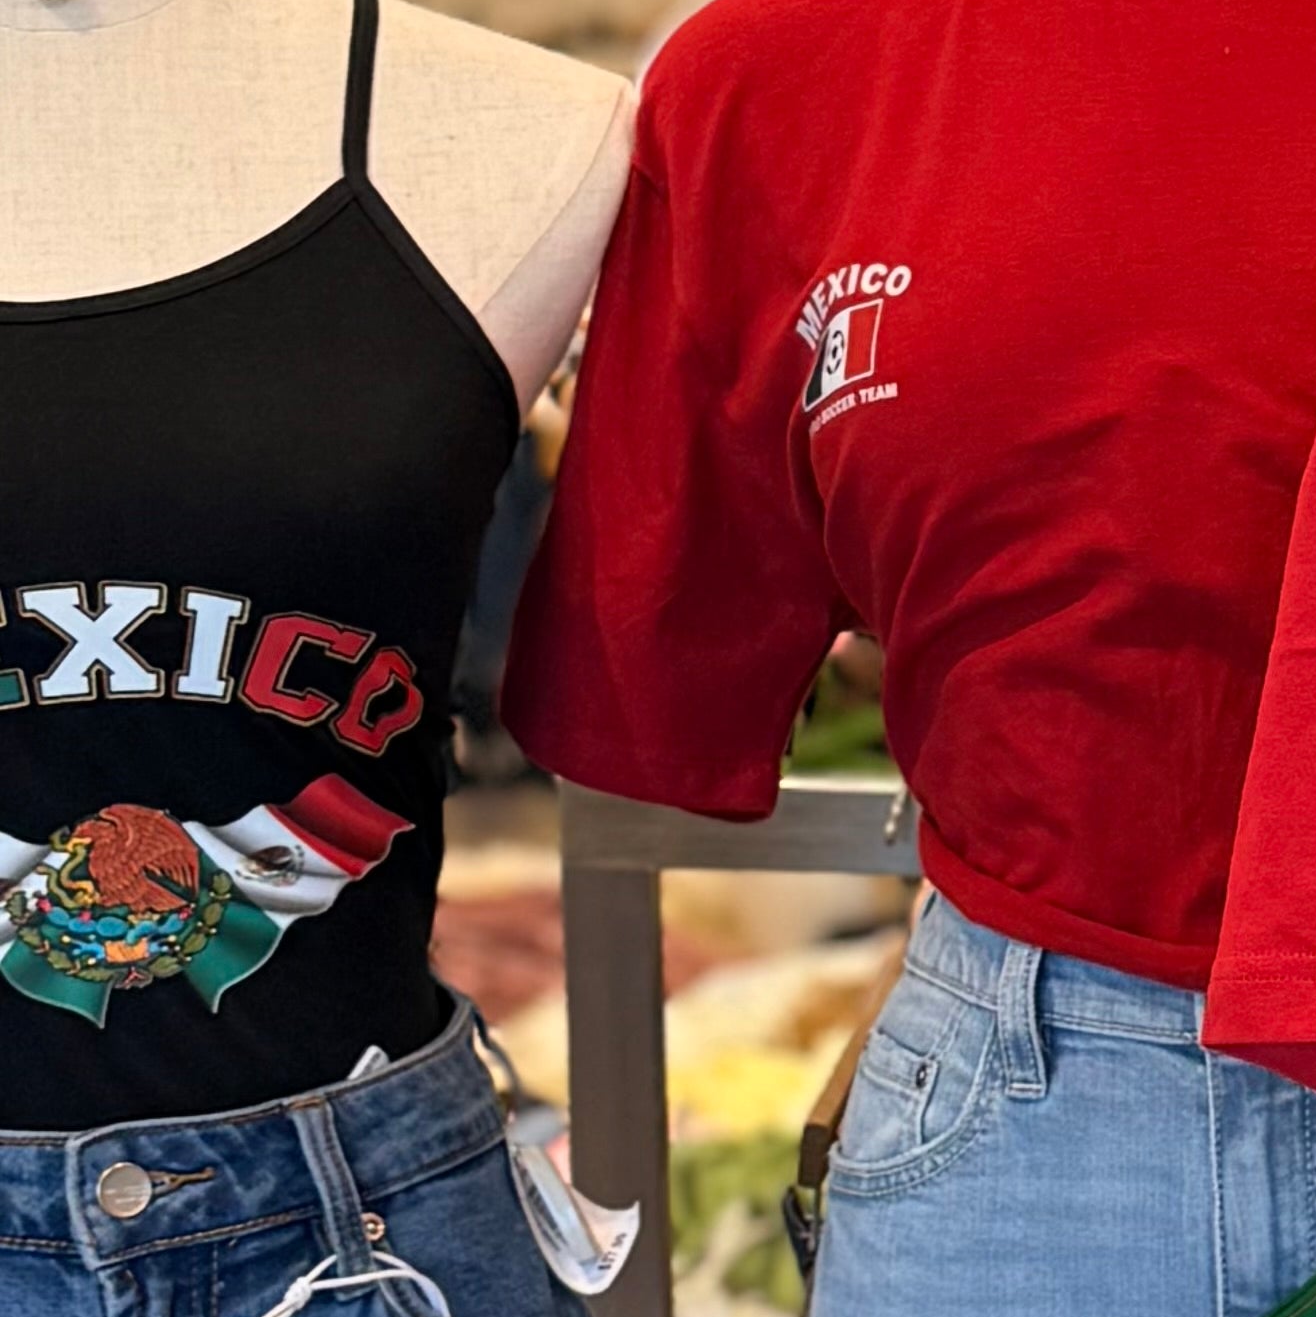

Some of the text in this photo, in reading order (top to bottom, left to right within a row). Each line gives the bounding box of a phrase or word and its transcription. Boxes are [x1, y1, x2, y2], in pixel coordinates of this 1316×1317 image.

[796, 263, 912, 351] MEXICO
[858, 382, 898, 404] TEAM
[0, 580, 424, 757] XICO
